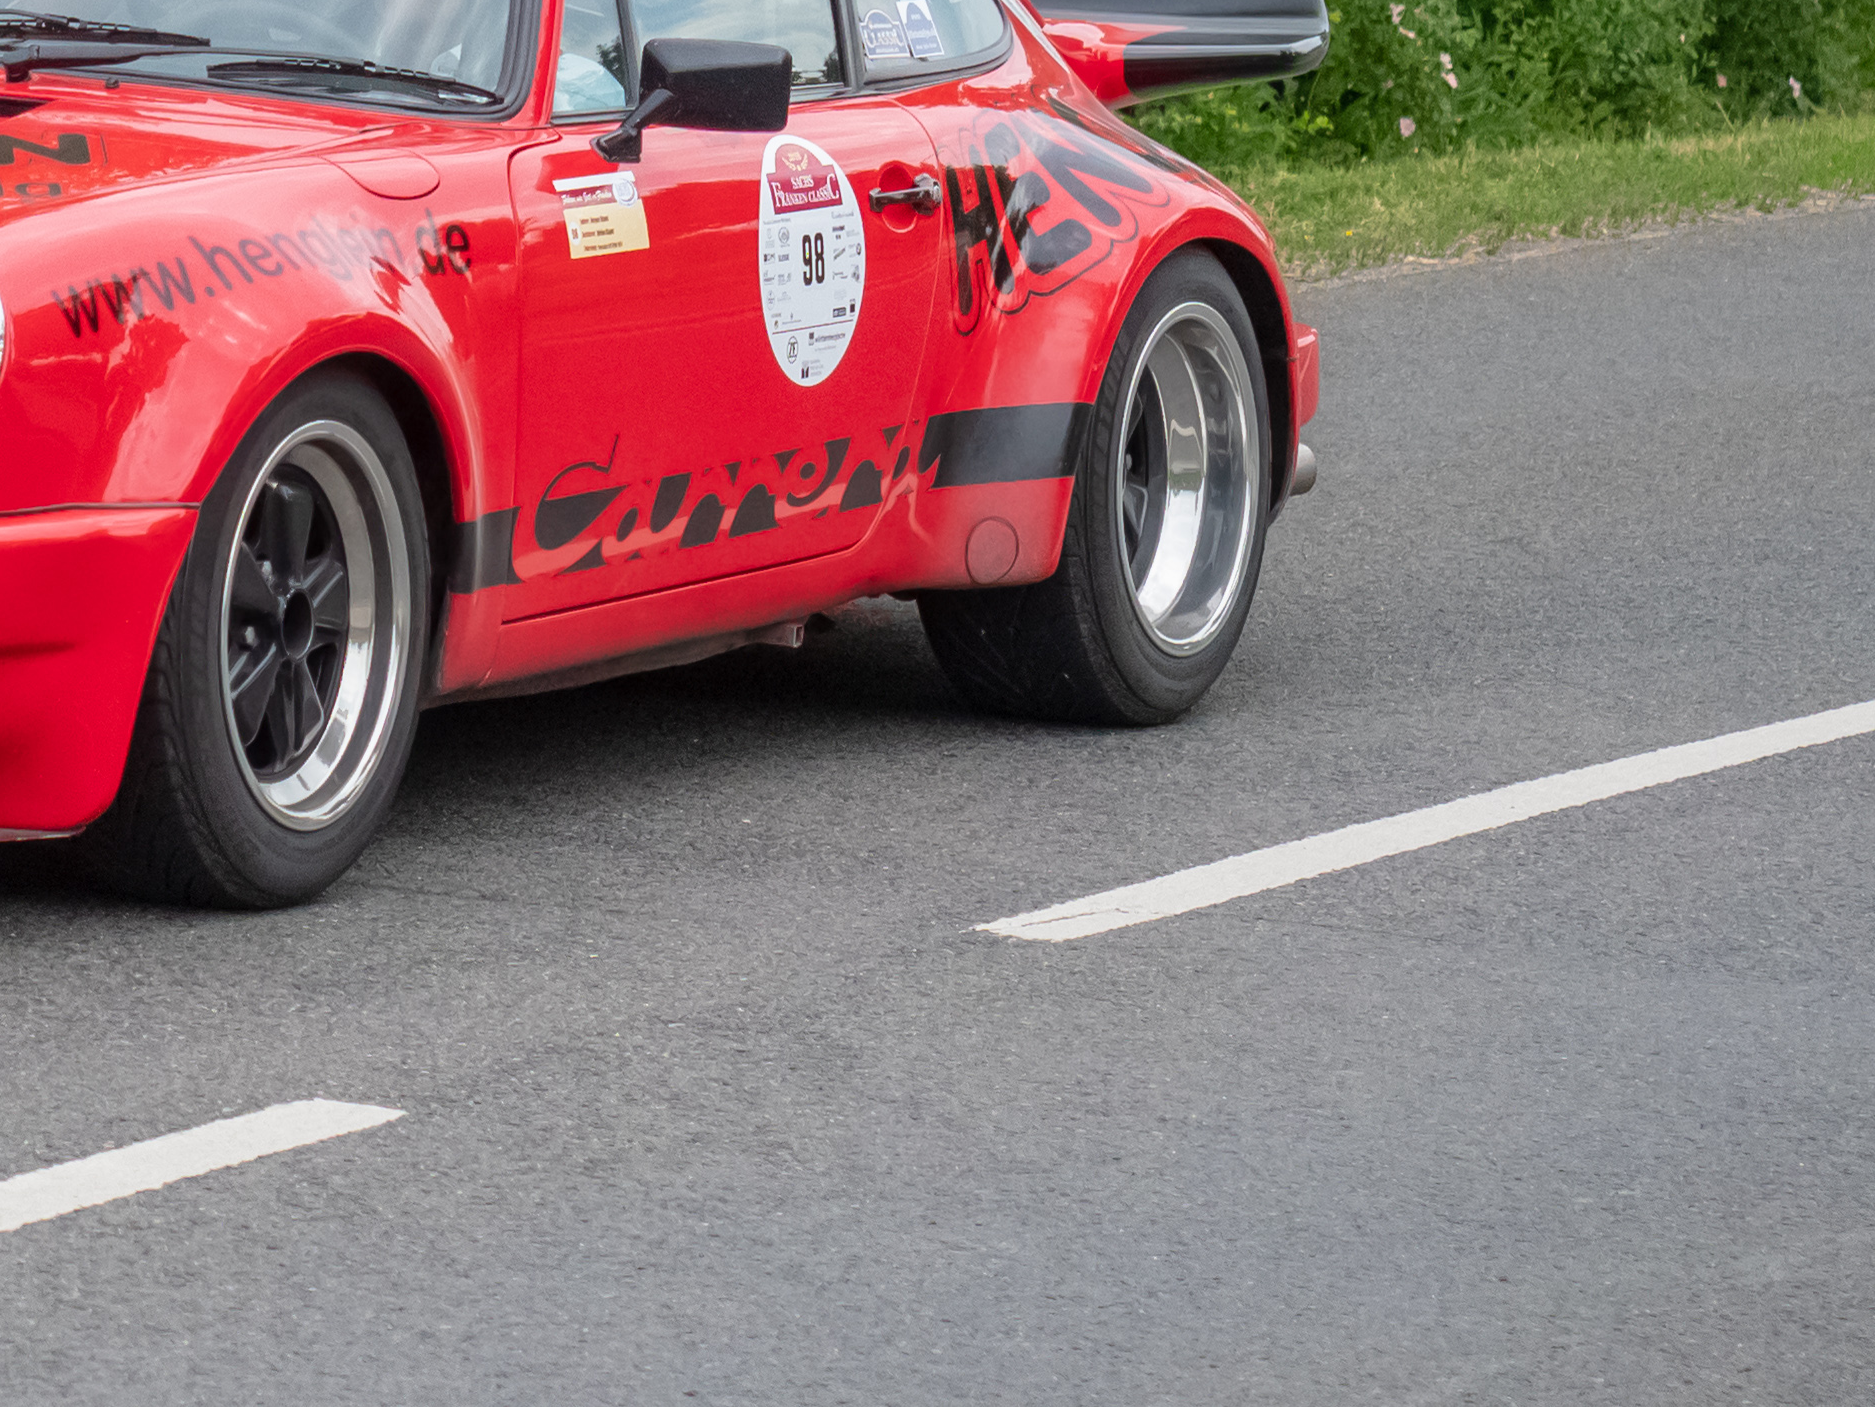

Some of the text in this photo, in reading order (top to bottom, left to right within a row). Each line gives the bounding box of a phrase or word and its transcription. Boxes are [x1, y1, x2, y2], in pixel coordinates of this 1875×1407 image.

[771, 173, 839, 207] FRANKEN CLASSIC
[790, 174, 814, 189] SACHS
[802, 232, 825, 286] 98
